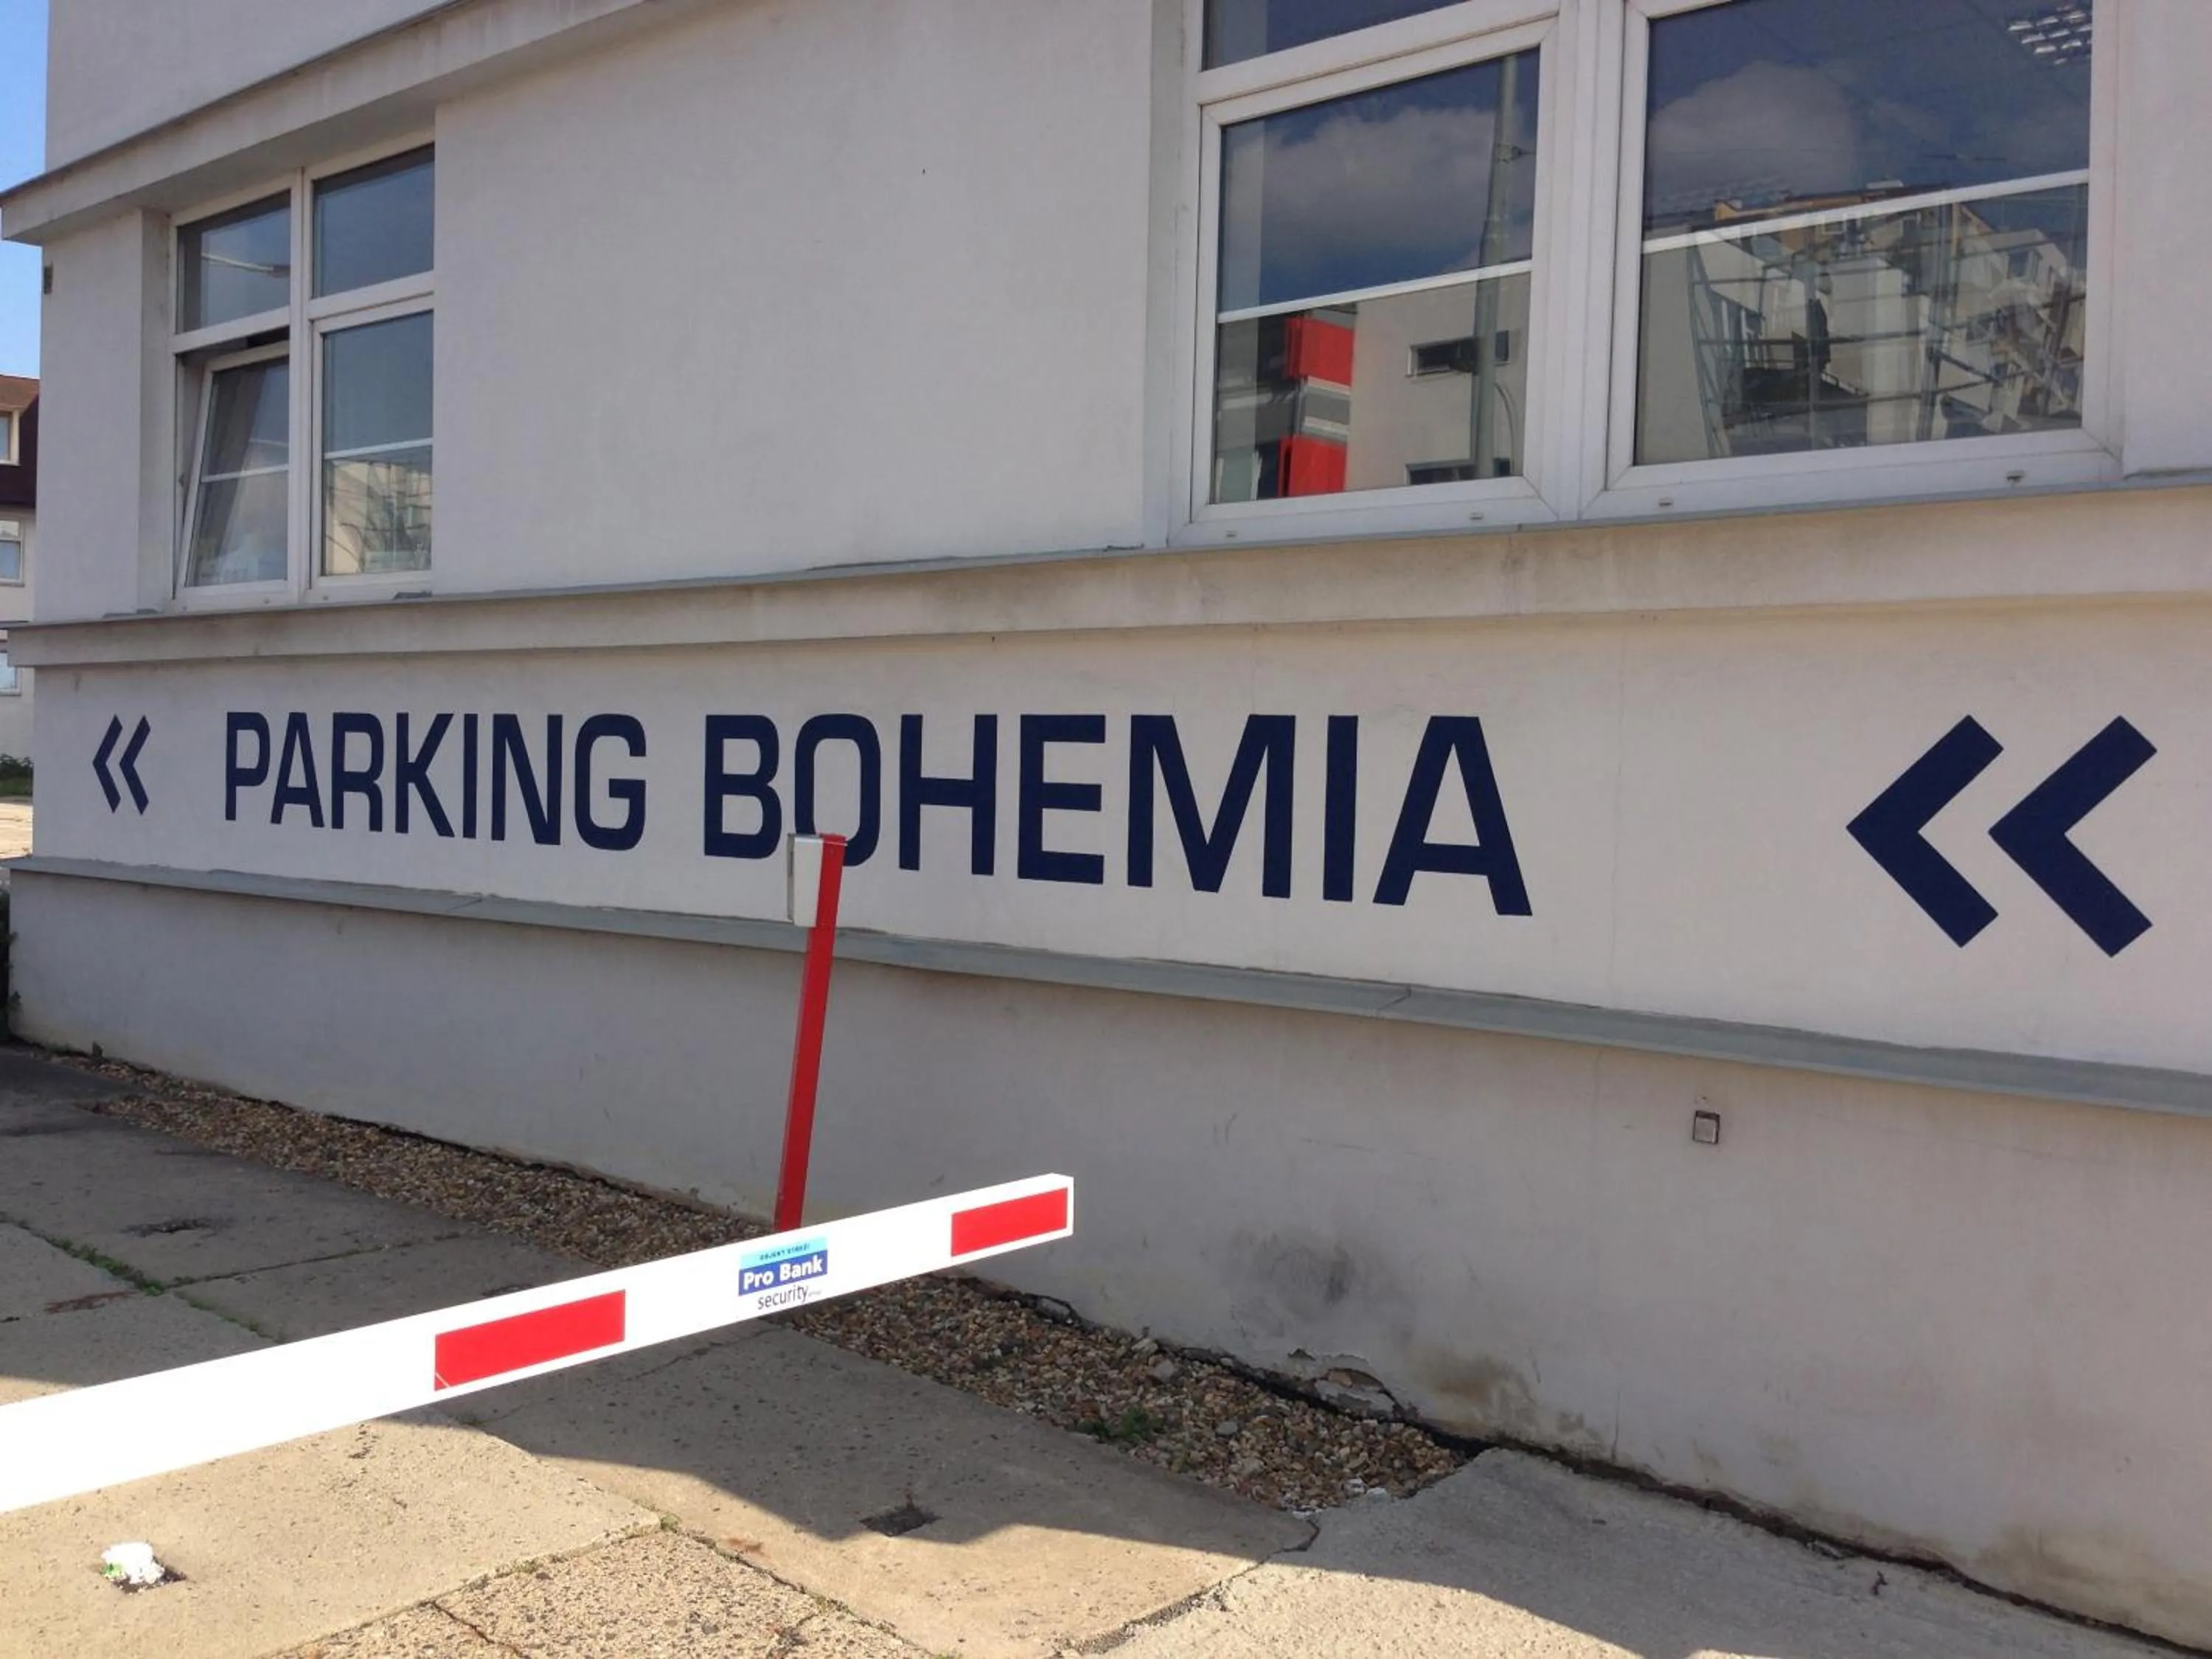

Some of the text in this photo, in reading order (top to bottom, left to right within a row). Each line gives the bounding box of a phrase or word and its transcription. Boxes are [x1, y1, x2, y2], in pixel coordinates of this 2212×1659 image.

[224, 711, 1534, 916] PARKING BOHEMIA
[743, 1255, 824, 1290] Pro Bank
[757, 1284, 809, 1310] security
